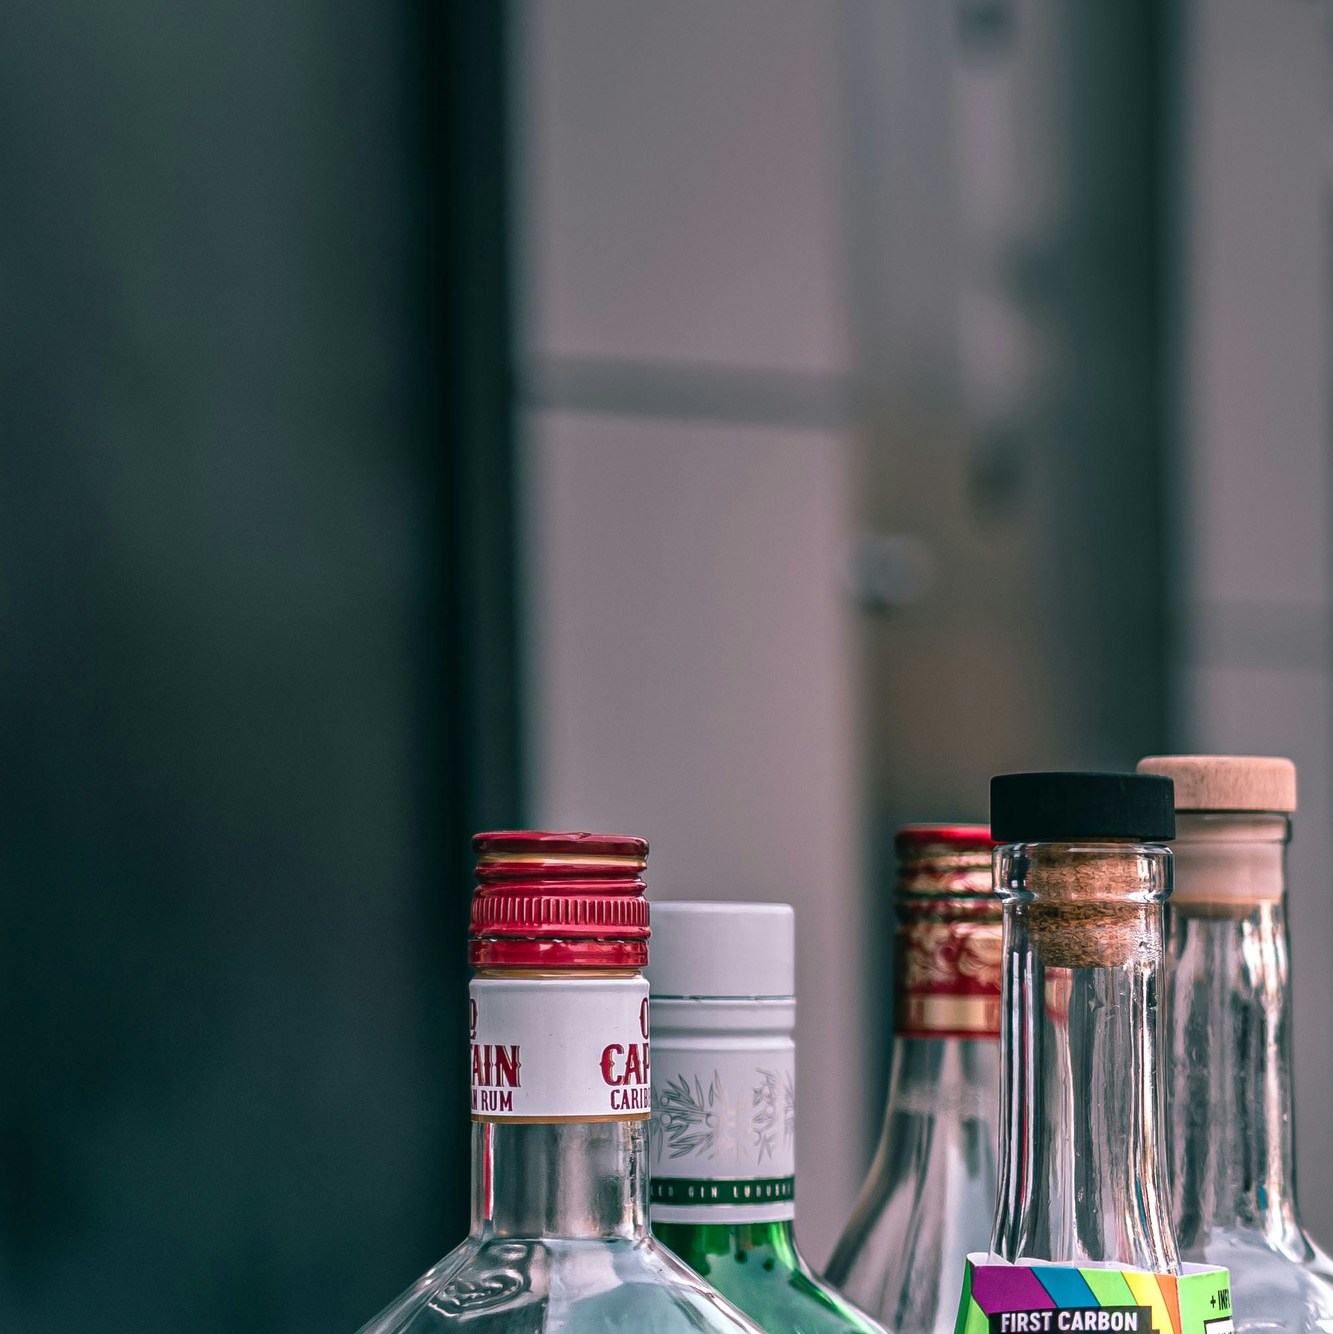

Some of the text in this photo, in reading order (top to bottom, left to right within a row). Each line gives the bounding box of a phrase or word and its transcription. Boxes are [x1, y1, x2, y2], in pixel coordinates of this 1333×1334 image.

[471, 1044, 521, 1088] AIN
[481, 1090, 513, 1112] RUM
[1001, 1311, 1138, 1333] FIRST CARBON
